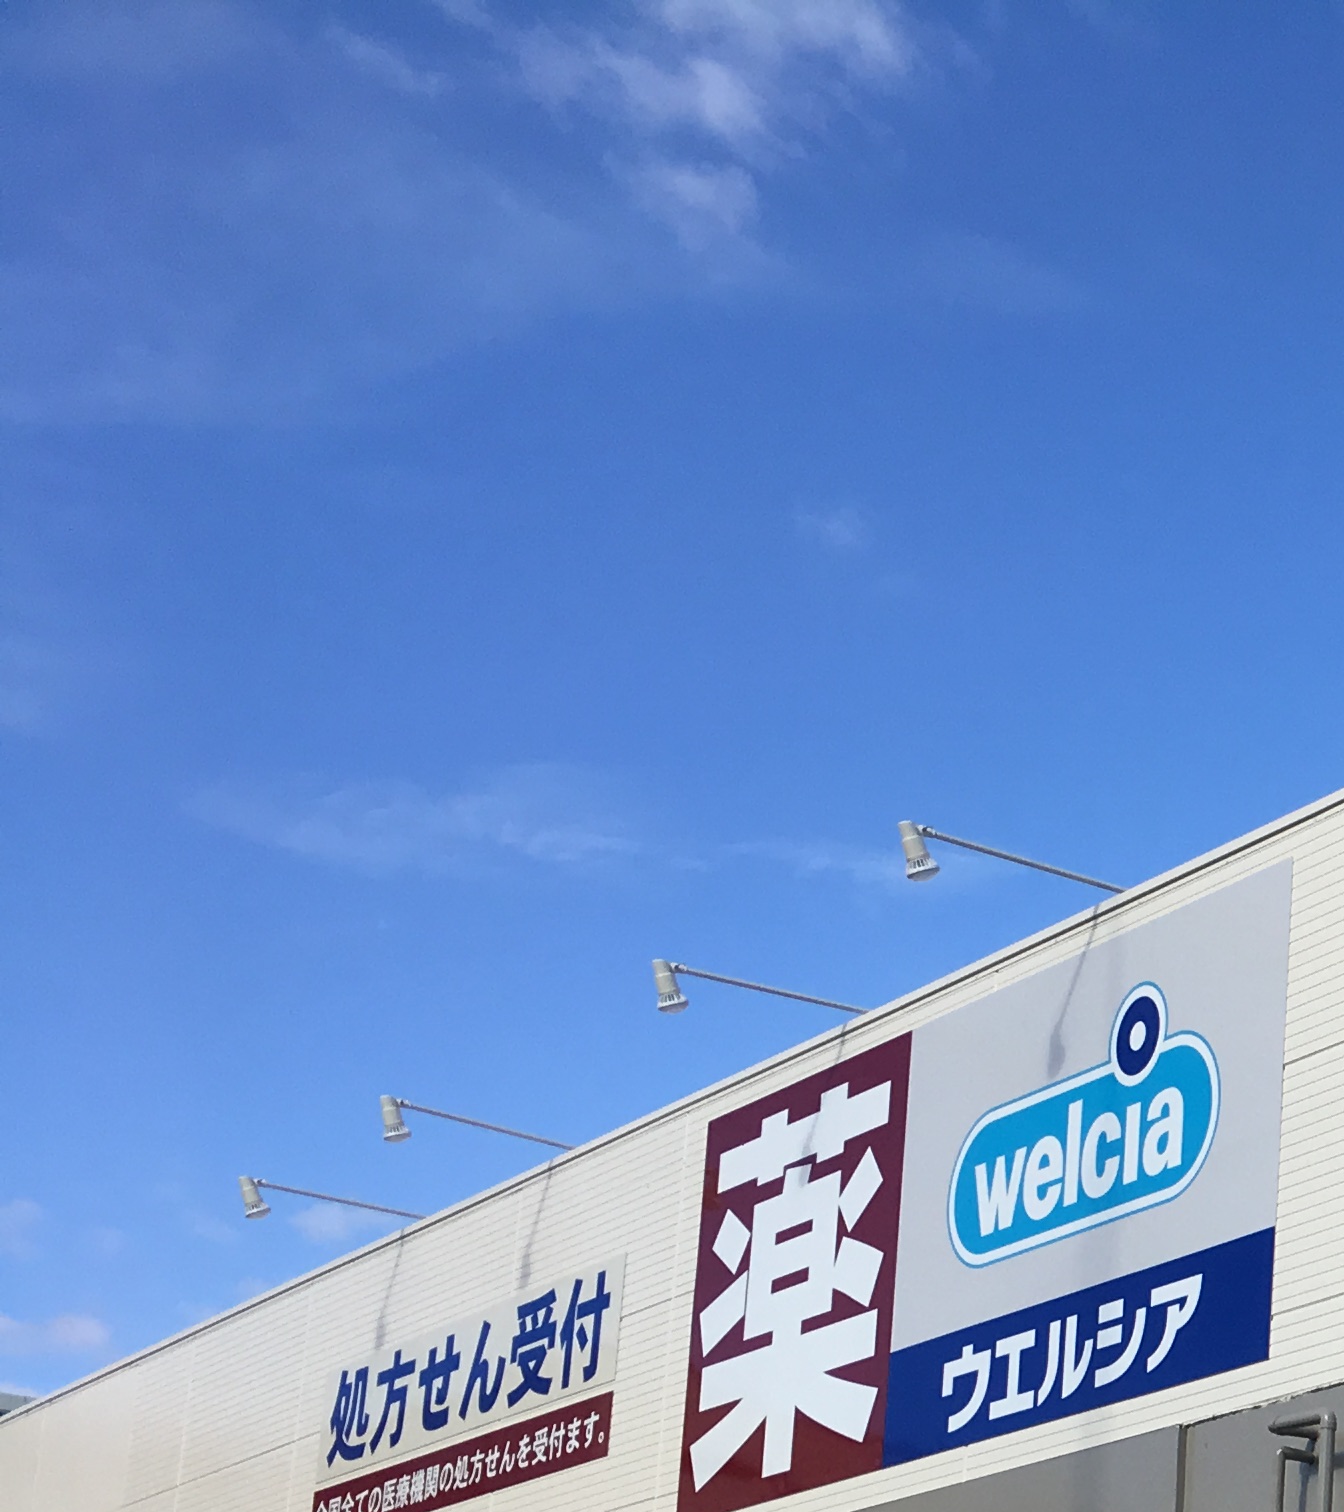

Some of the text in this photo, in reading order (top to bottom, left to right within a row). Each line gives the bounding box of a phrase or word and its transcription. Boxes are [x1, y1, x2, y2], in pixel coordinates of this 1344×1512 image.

[975, 1087, 1184, 1237] welcia
[327, 1270, 612, 1468] 処方せん受付
[690, 1081, 892, 1493] 薬
[941, 1274, 1204, 1434] ウエルシア
